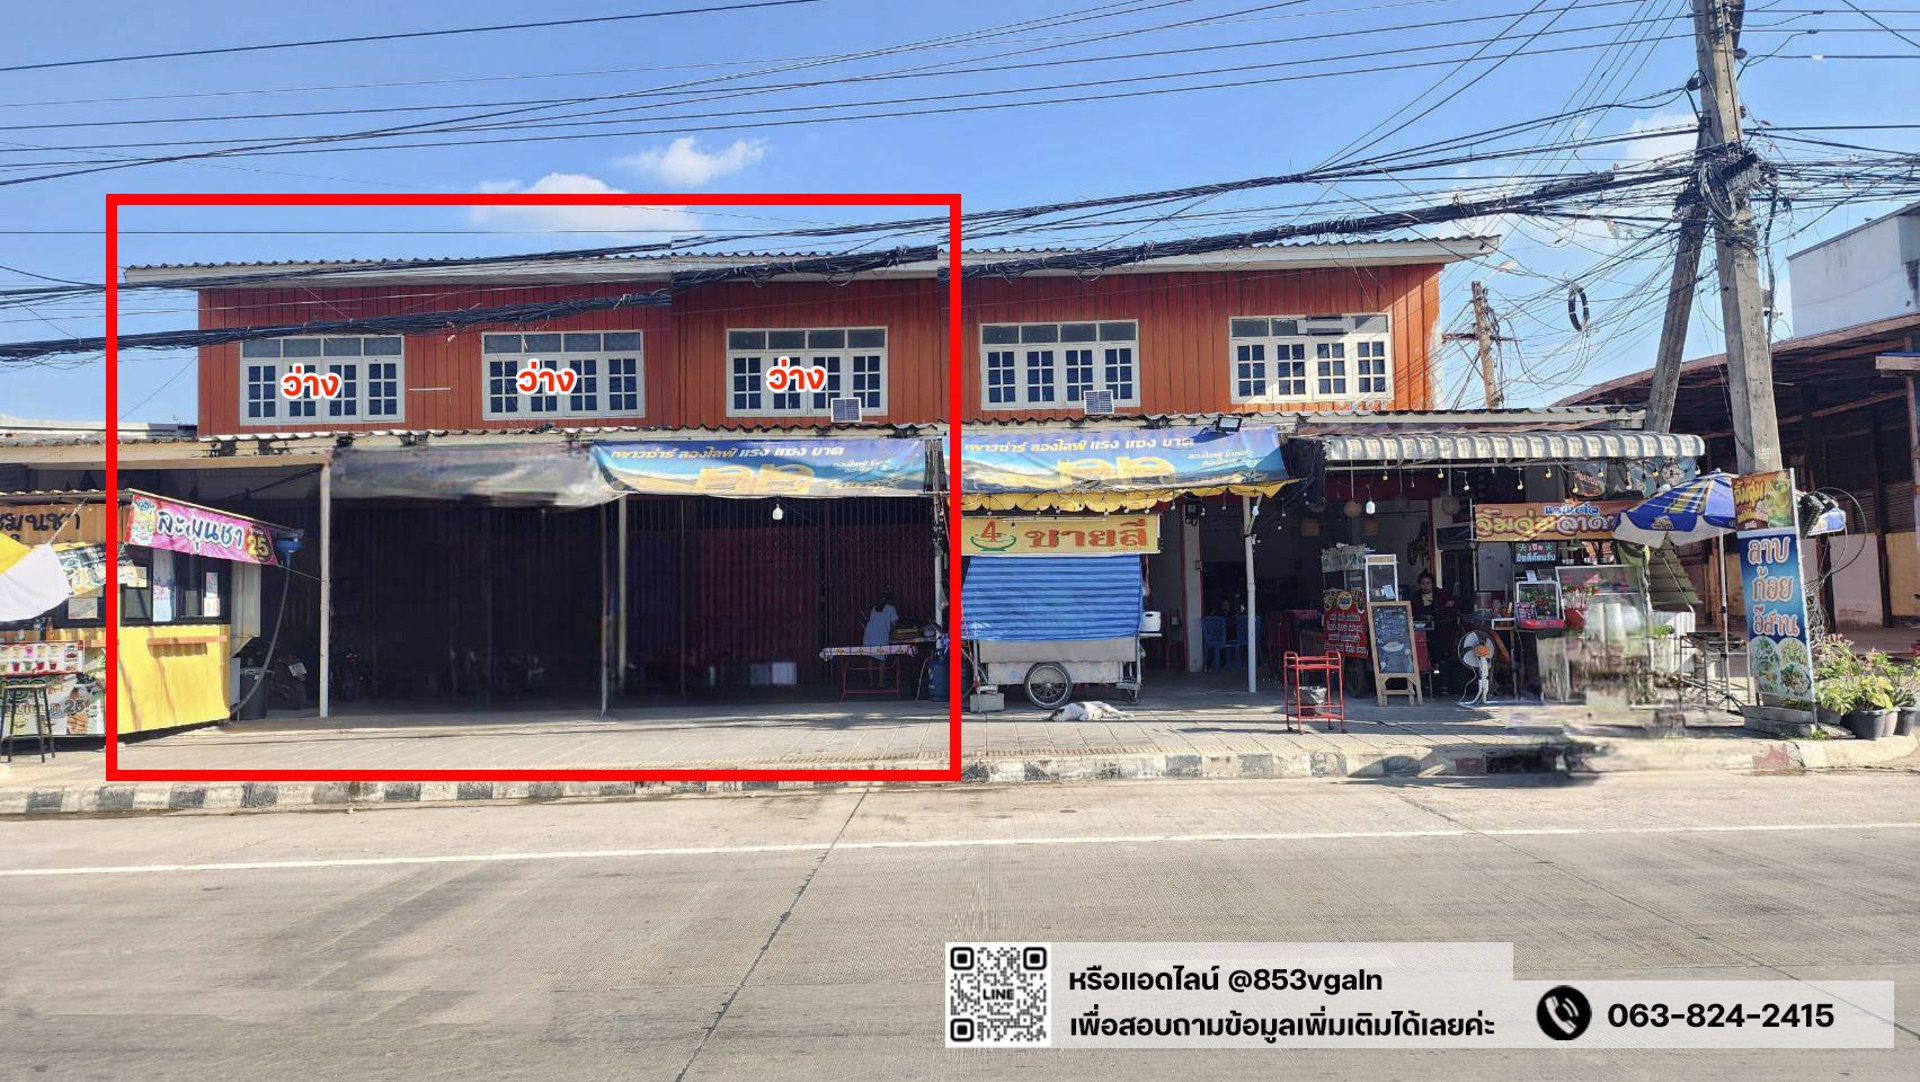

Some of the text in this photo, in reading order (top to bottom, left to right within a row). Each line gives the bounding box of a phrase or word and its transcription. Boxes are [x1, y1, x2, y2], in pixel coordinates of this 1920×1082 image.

[739, 447, 770, 459] แรง
[1090, 440, 1120, 450] แรง
[157, 510, 244, 551] ละมุนชา
[248, 531, 269, 558] 25
[1025, 518, 1148, 549] ชายสี่
[1748, 537, 1791, 565] ลาบ
[1752, 566, 1795, 602] ก้อย
[1753, 604, 1800, 637] อีสาน
